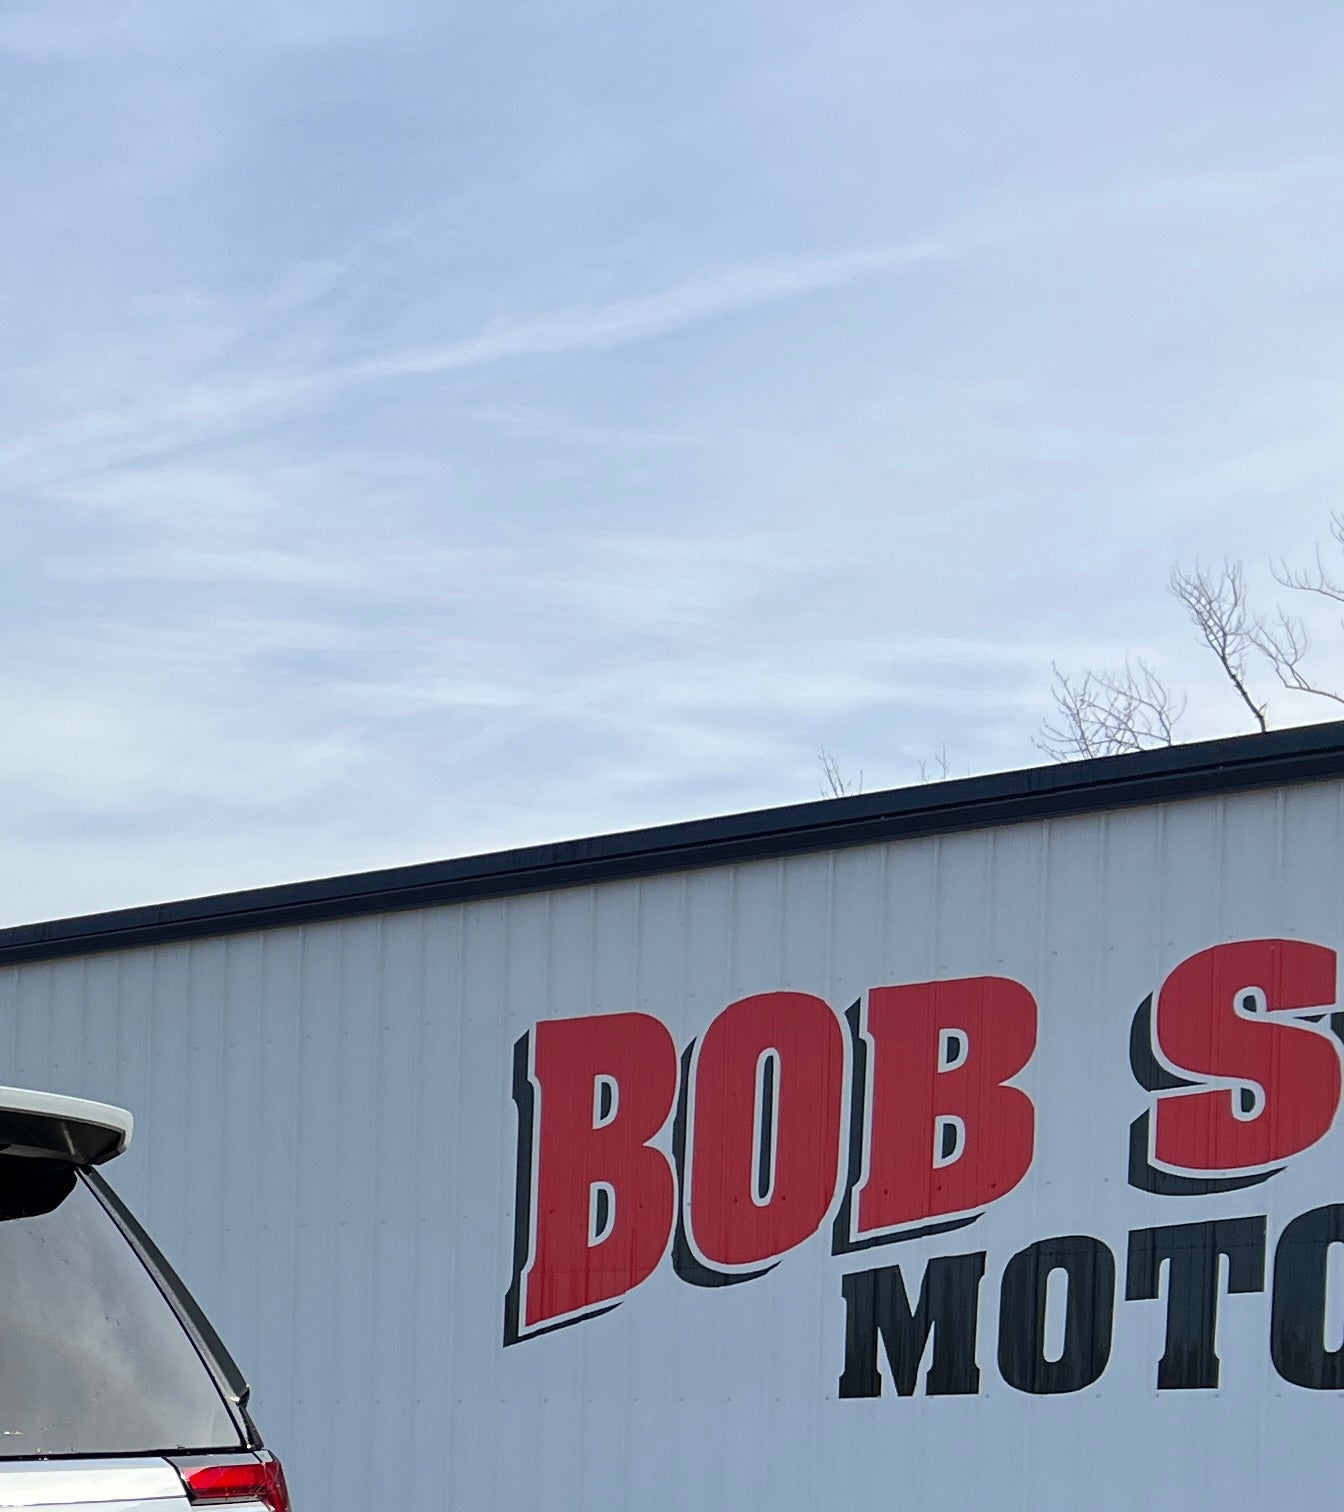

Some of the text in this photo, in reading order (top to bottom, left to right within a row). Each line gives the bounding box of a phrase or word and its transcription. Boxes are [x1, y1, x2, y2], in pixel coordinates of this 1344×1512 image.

[503, 938, 1344, 1347] BOB S
[838, 1203, 1344, 1398] MOTO
